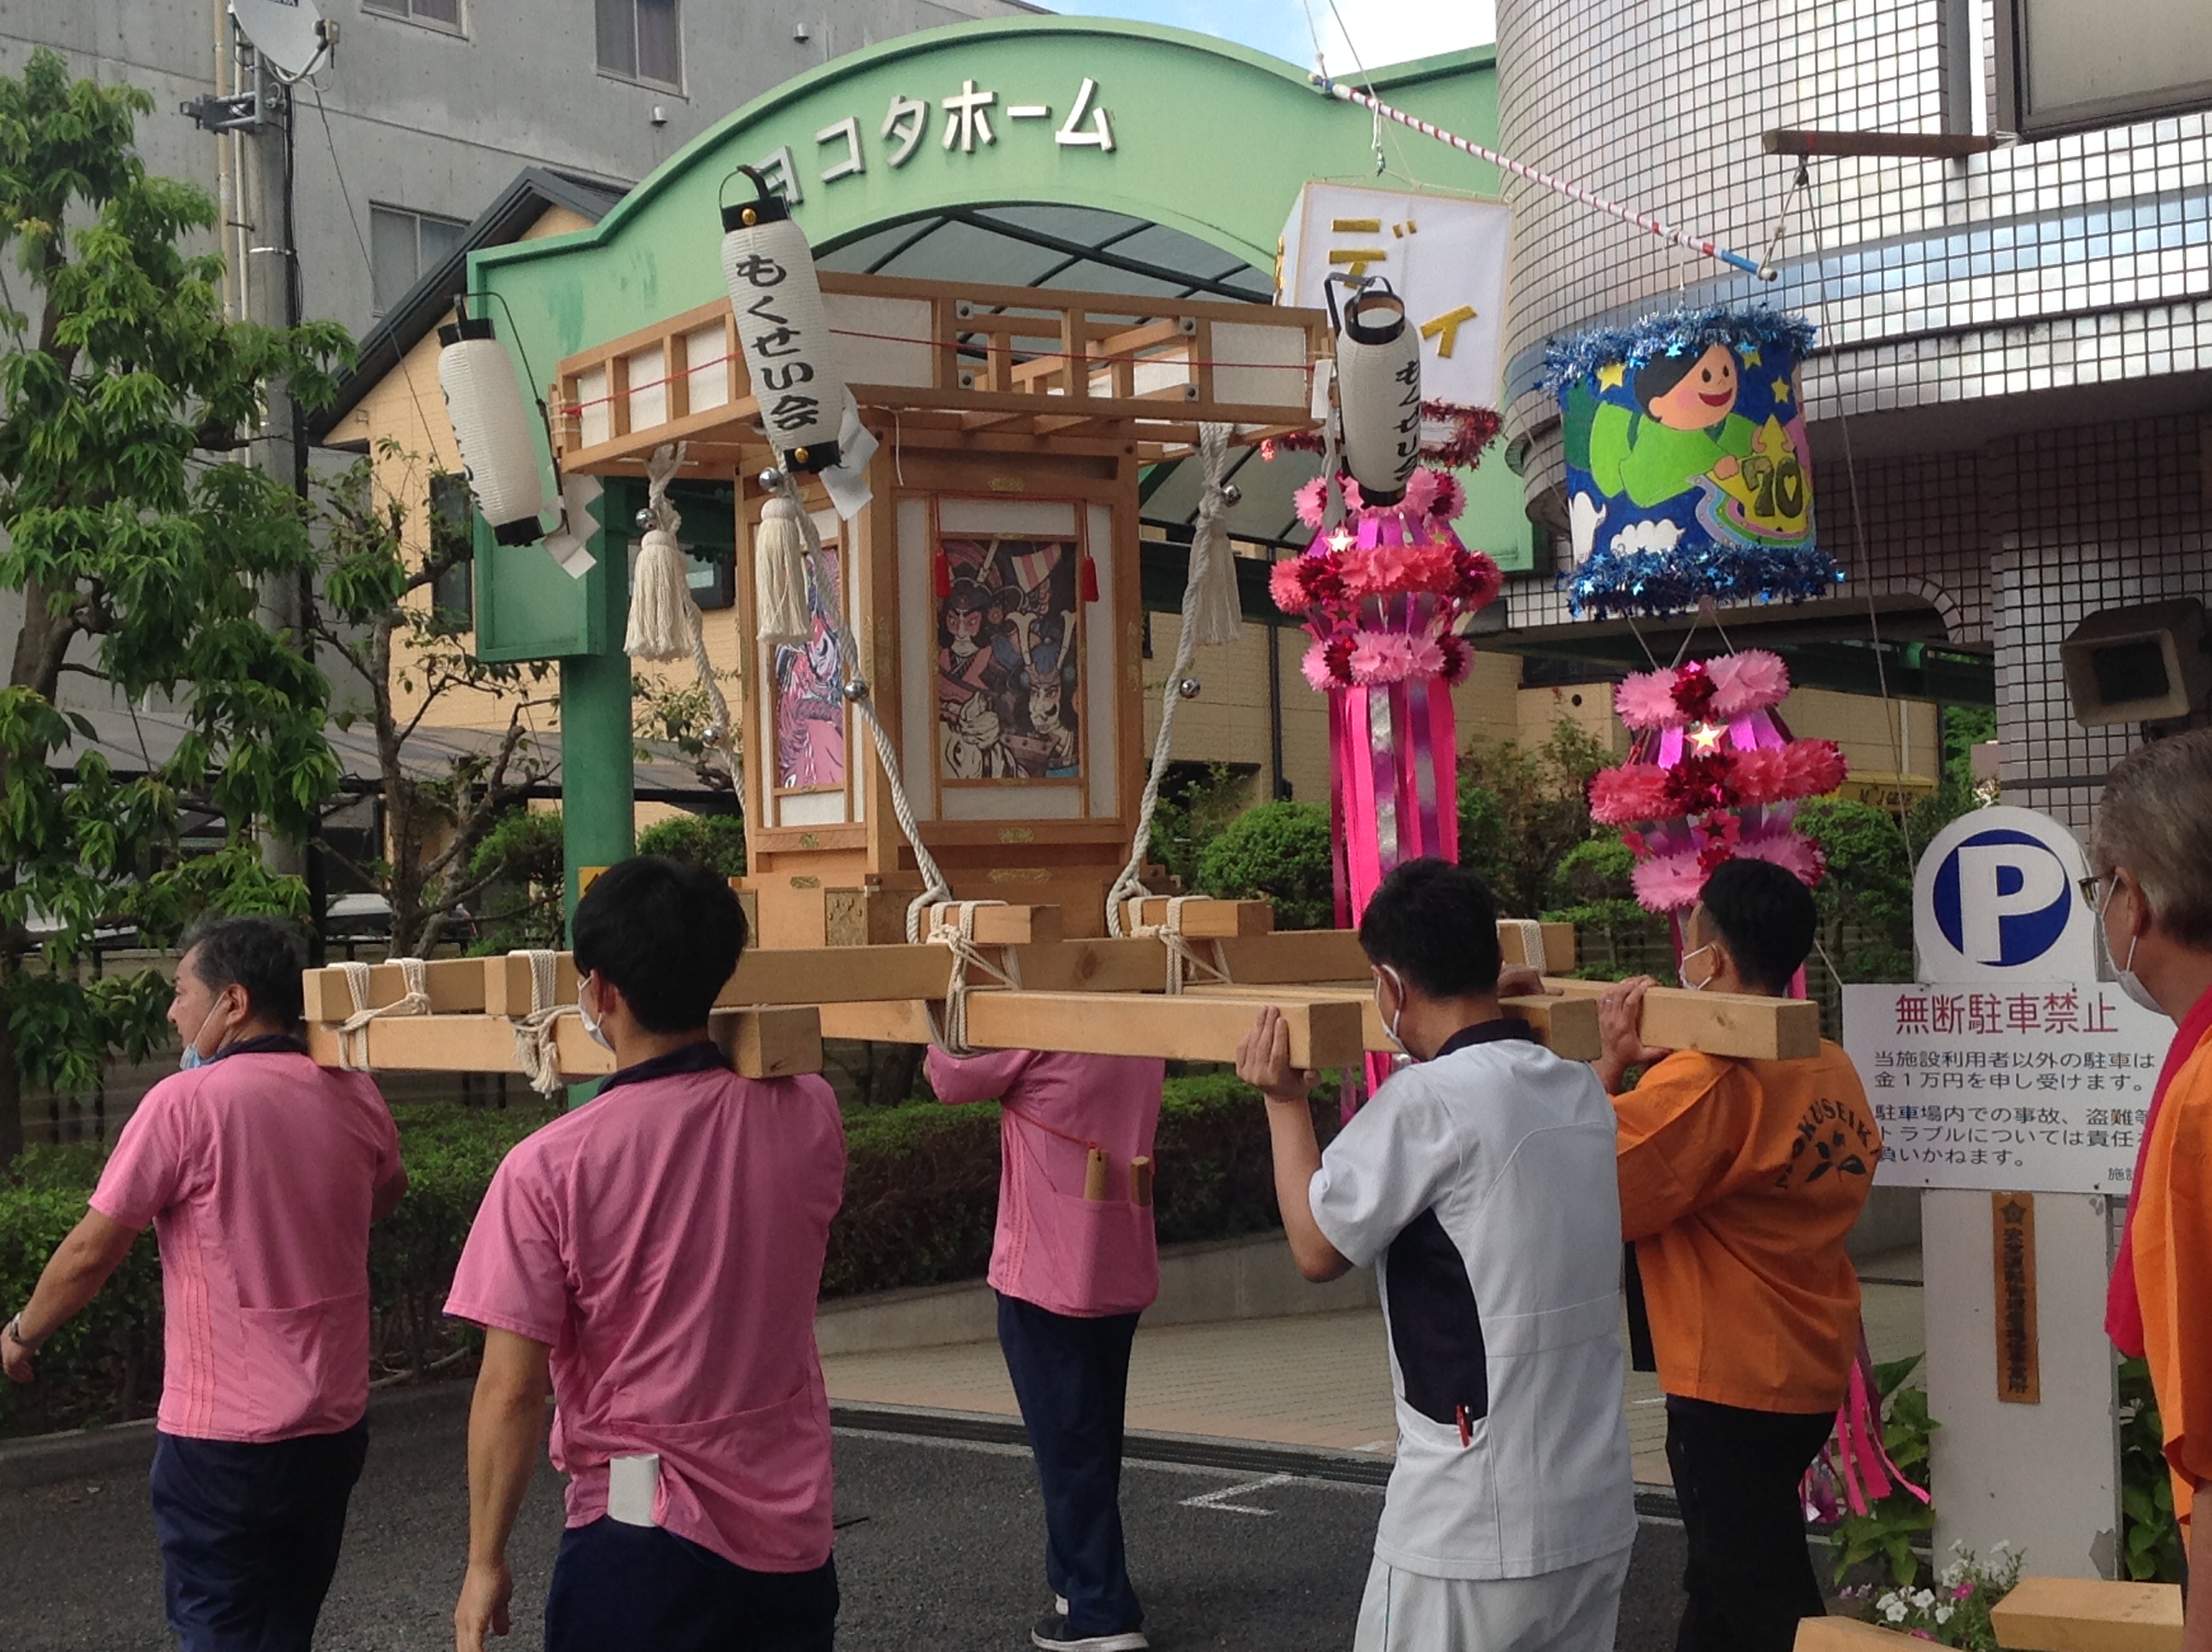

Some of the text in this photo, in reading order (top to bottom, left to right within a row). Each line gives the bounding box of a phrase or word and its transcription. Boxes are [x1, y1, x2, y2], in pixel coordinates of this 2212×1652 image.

[753, 77, 1116, 206] ヨコタホーム
[736, 253, 819, 431] もくせい会
[1742, 456, 1803, 518] 70
[1958, 843, 2065, 963] P
[1895, 992, 2119, 1035] 無断駐車禁止
[1874, 1050, 2156, 1069] 当施設利用者以外の駐車は
[1880, 1126, 2143, 1148] トラブルについては責任
